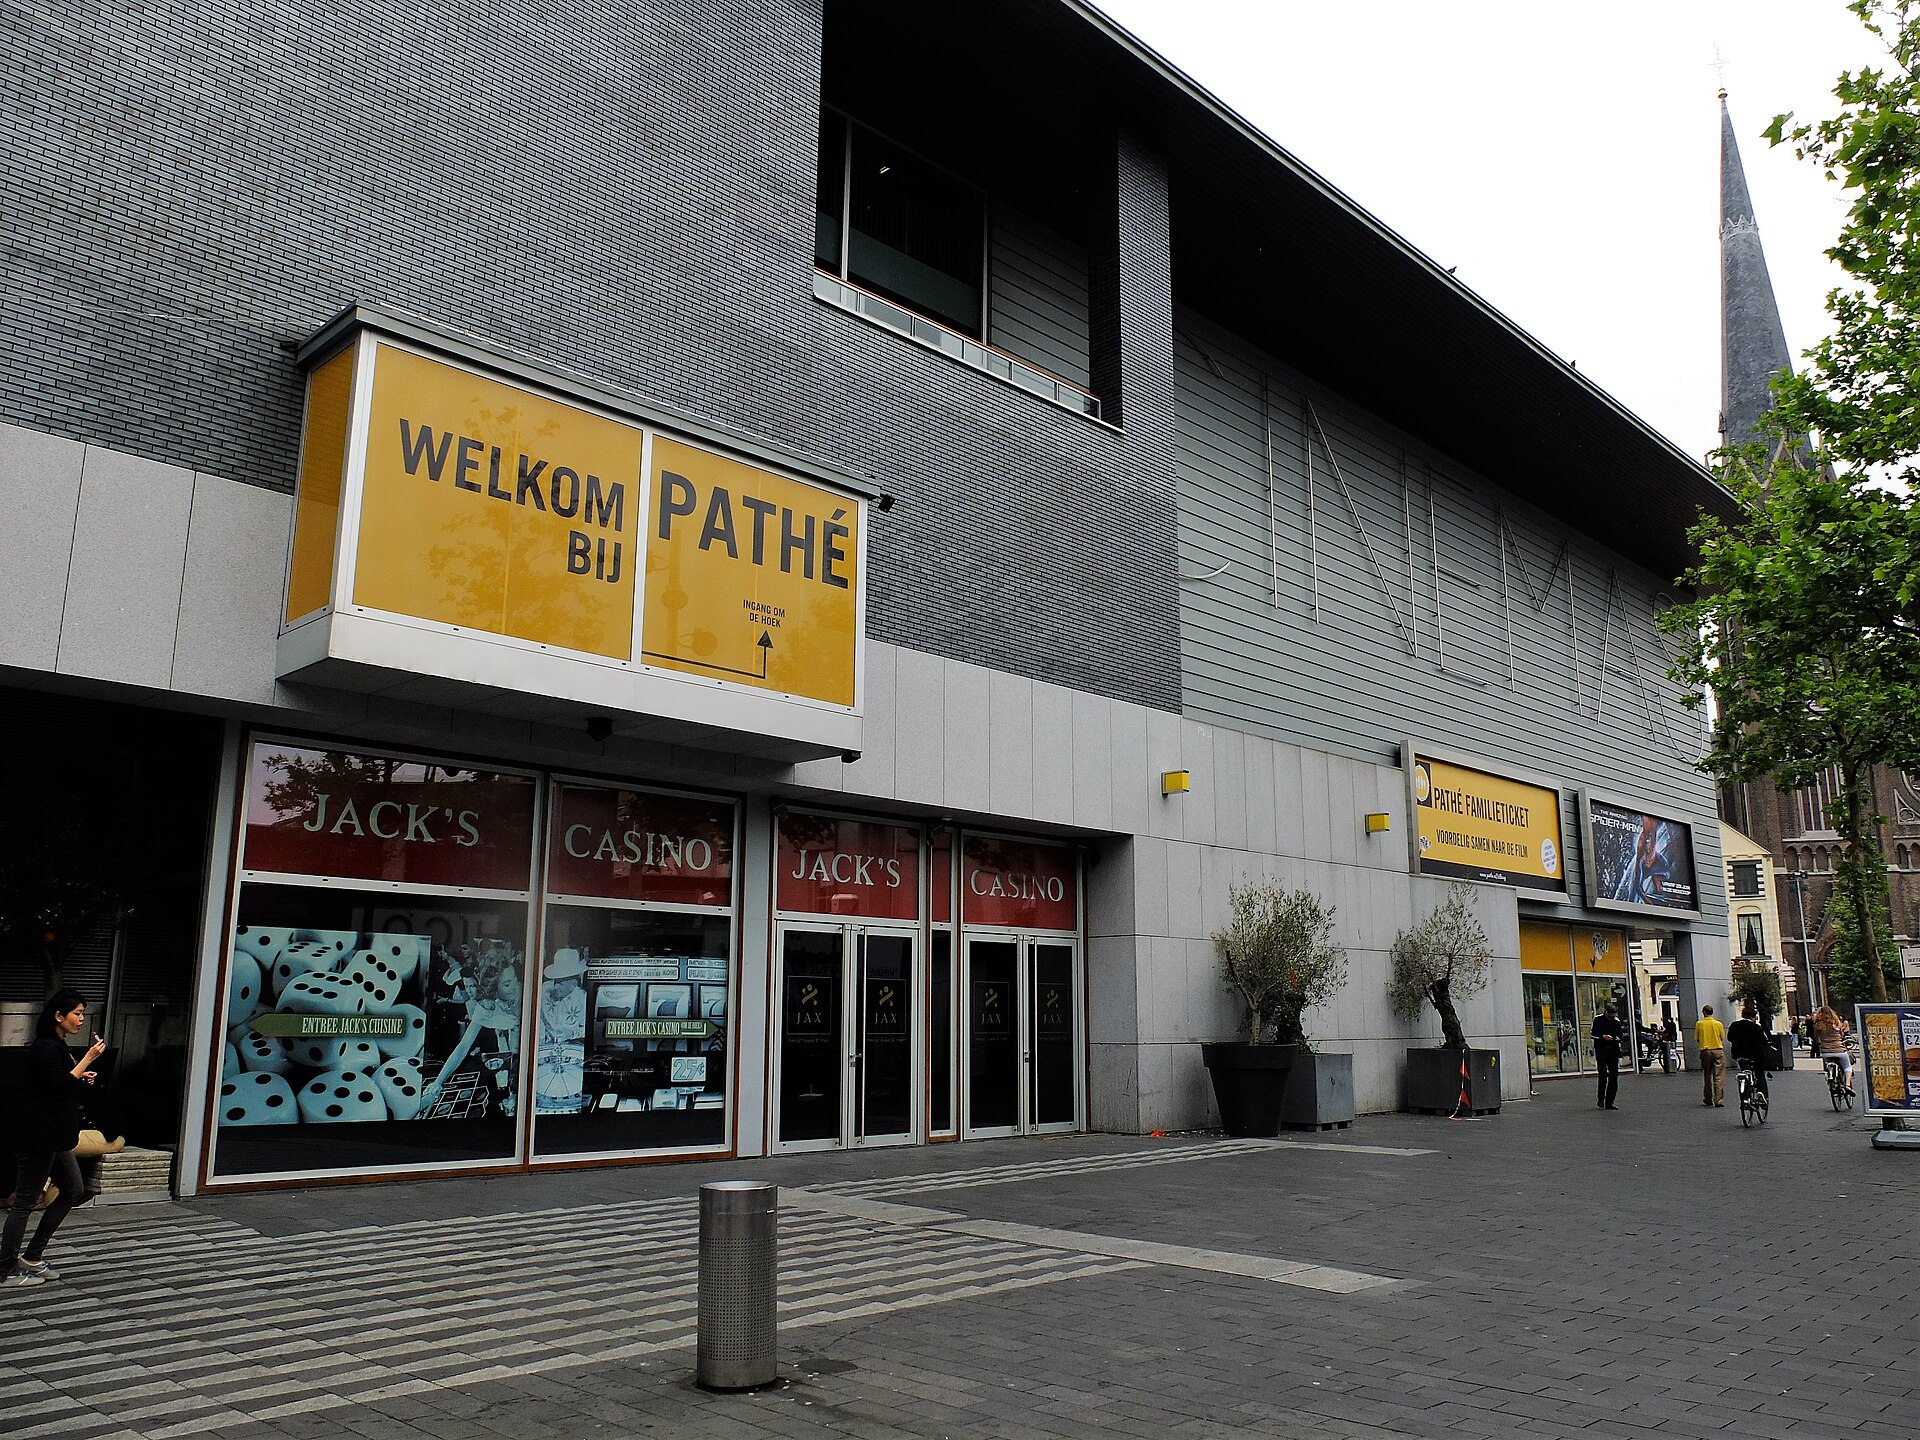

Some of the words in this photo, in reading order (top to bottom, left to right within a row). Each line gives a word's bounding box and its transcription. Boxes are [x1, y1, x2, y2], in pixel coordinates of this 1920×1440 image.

[400, 418, 625, 531] WELKOM
[658, 470, 850, 589] PATHÉ
[567, 530, 621, 584] BIJ
[743, 599, 771, 614] INGANG
[773, 607, 786, 617] OM
[749, 612, 759, 622] DE
[761, 615, 781, 628] HOEK
[1434, 787, 1463, 815] PATHÉ
[1466, 794, 1529, 828] FAMILIETICKET
[303, 793, 480, 848] JACK'S
[564, 823, 712, 872] CASINO
[1436, 828, 1470, 848] VOORDELIG
[1471, 836, 1490, 853] SAMEN
[1491, 840, 1506, 855] NAAR
[1507, 843, 1514, 856] DE
[1515, 844, 1529, 858] FILM
[792, 849, 902, 889] JACK'S
[970, 868, 1064, 903] CASINO
[301, 1017, 339, 1034] ENTREE
[339, 1018, 368, 1034] JACK'S
[369, 1018, 403, 1034] CUISINE
[796, 1012, 822, 1024] JAX
[874, 1012, 897, 1025] JAX
[981, 1013, 1001, 1025] JAX
[1043, 1013, 1062, 1025] JAX
[607, 1021, 634, 1035] ENTREE
[635, 1021, 657, 1035] JACK'S
[657, 1021, 680, 1035] CASINO
[1870, 1050, 1901, 1060] VERSE
[1872, 1065, 1902, 1076] FRIET
